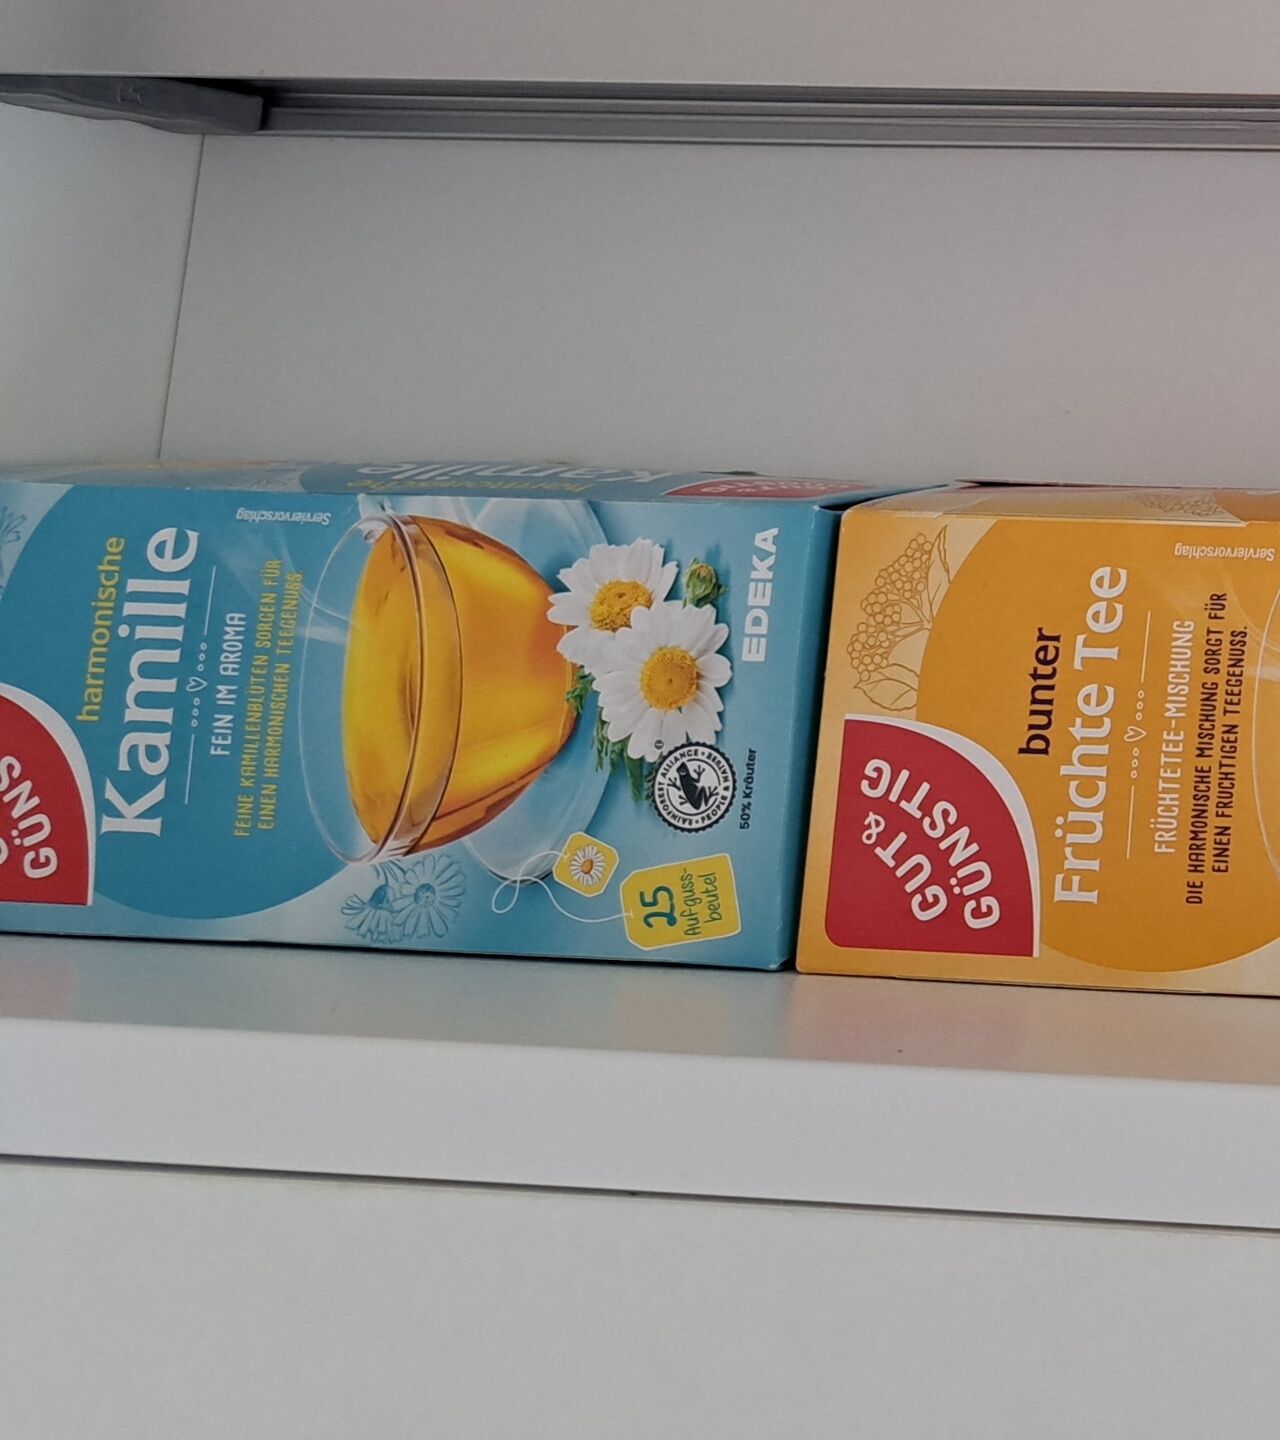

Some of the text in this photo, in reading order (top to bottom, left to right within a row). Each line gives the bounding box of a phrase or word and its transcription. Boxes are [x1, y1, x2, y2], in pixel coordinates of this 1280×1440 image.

[742, 527, 779, 662] EDEKA
[1174, 543, 1276, 561] Serviervorschlag
[76, 535, 125, 722] harmonische
[100, 526, 200, 838] Kamille
[209, 613, 247, 755] FEIN IM AROMA
[1017, 626, 1061, 757] bunter
[234, 559, 282, 836] FEINE KAMILLENBLÜTEN SORGEN FÜR
[263, 663, 290, 777] HARMONISCHEN
[1053, 565, 1129, 905] Früchte Tee
[1150, 620, 1195, 853] FRÜCHTETEE-MISCHUNG
[1185, 593, 1228, 904] DIE HARMONISCHE MISCHUNG SORGT FÜR
[1211, 626, 1248, 873] EINEN FRUCHTIGEN TEEGENUSS.
[258, 784, 277, 829] EINEN
[740, 801, 752, 830] 50%
[860, 758, 1001, 931] GÜNSTIG
[861, 811, 948, 922] GUT &
[638, 884, 678, 929] 25
[683, 867, 704, 937] Aufguss-
[703, 870, 722, 923] beutel
